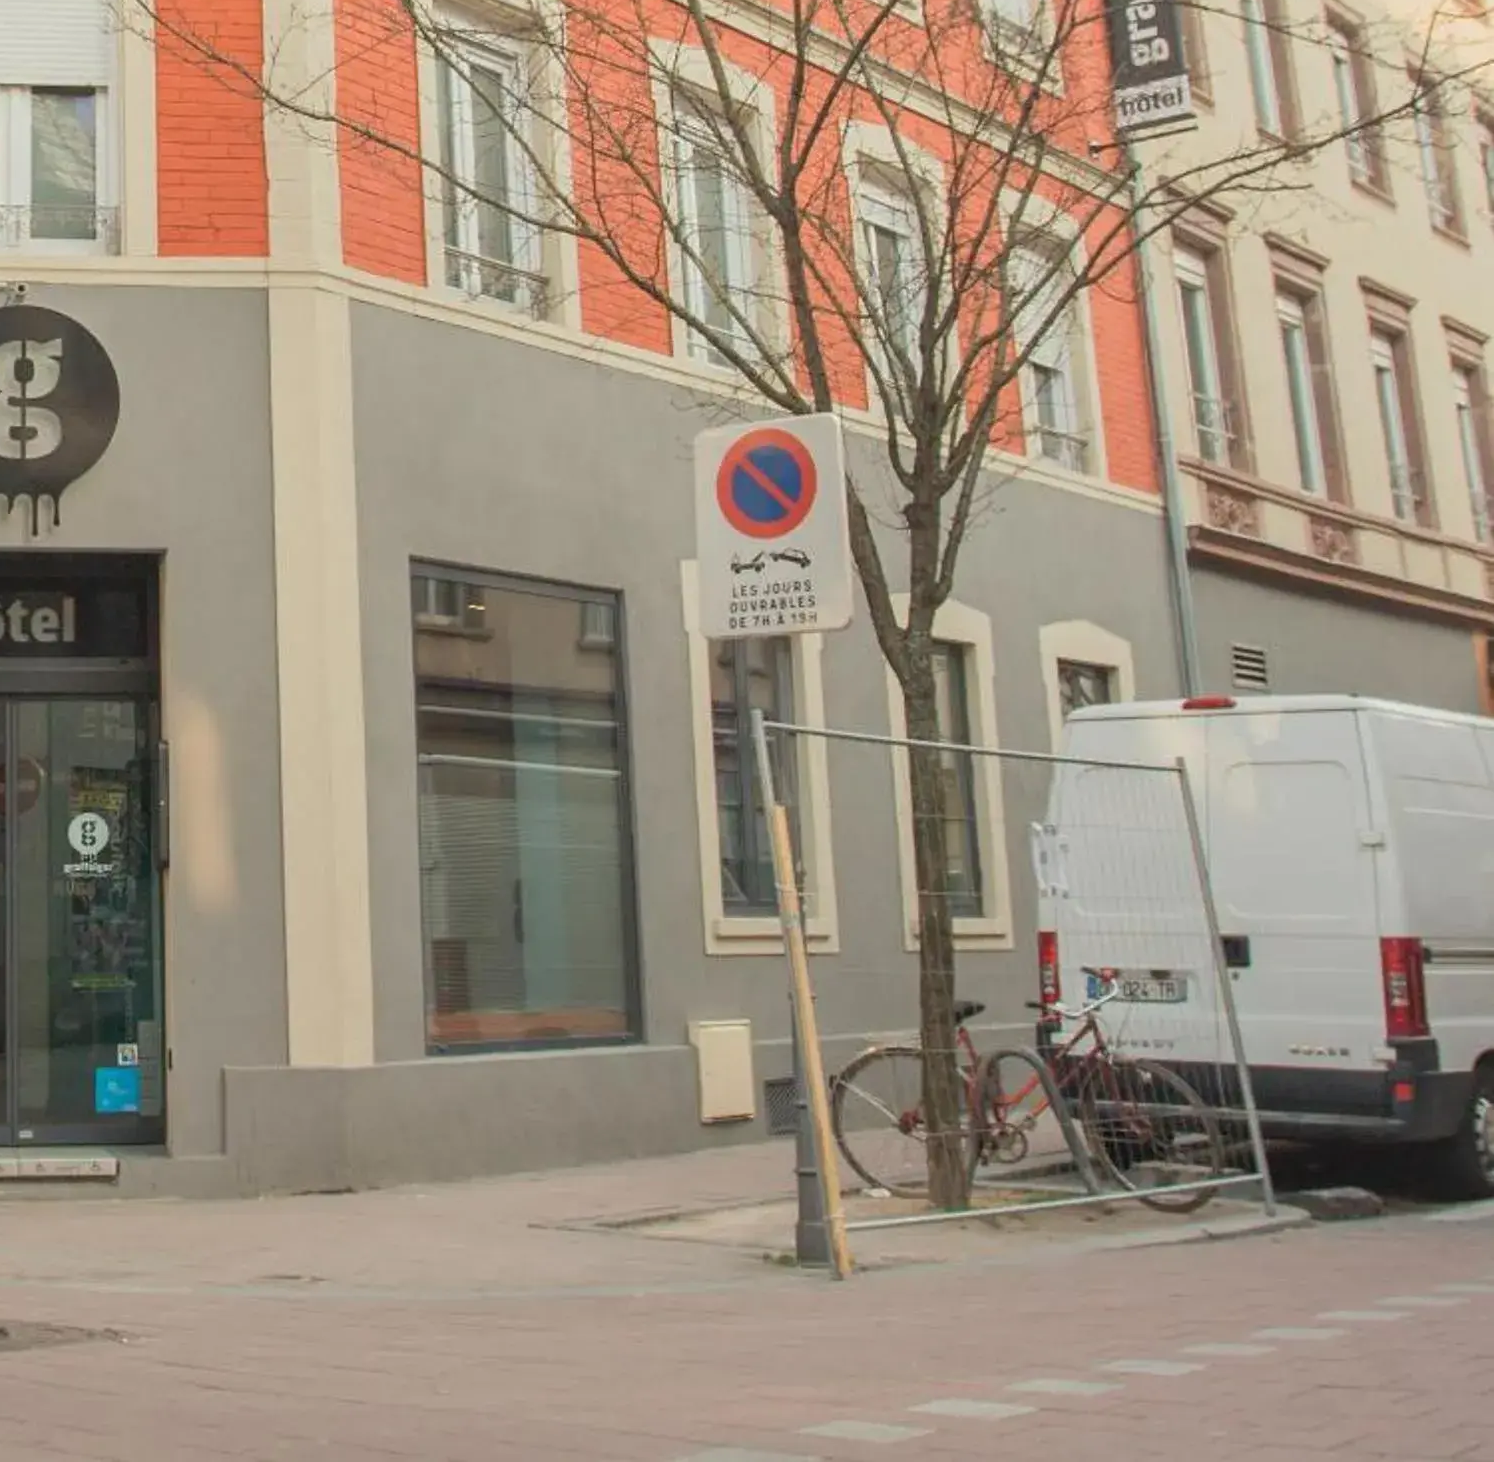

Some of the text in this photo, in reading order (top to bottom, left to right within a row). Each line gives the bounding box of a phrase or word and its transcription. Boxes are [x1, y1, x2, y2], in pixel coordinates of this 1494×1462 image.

[1119, 86, 1185, 118] hôtel
[732, 578, 812, 599] LES JOURS
[729, 594, 816, 614] OUVRABLES
[729, 616, 747, 630] DE
[752, 614, 771, 627] 7H
[791, 611, 818, 625] 19H
